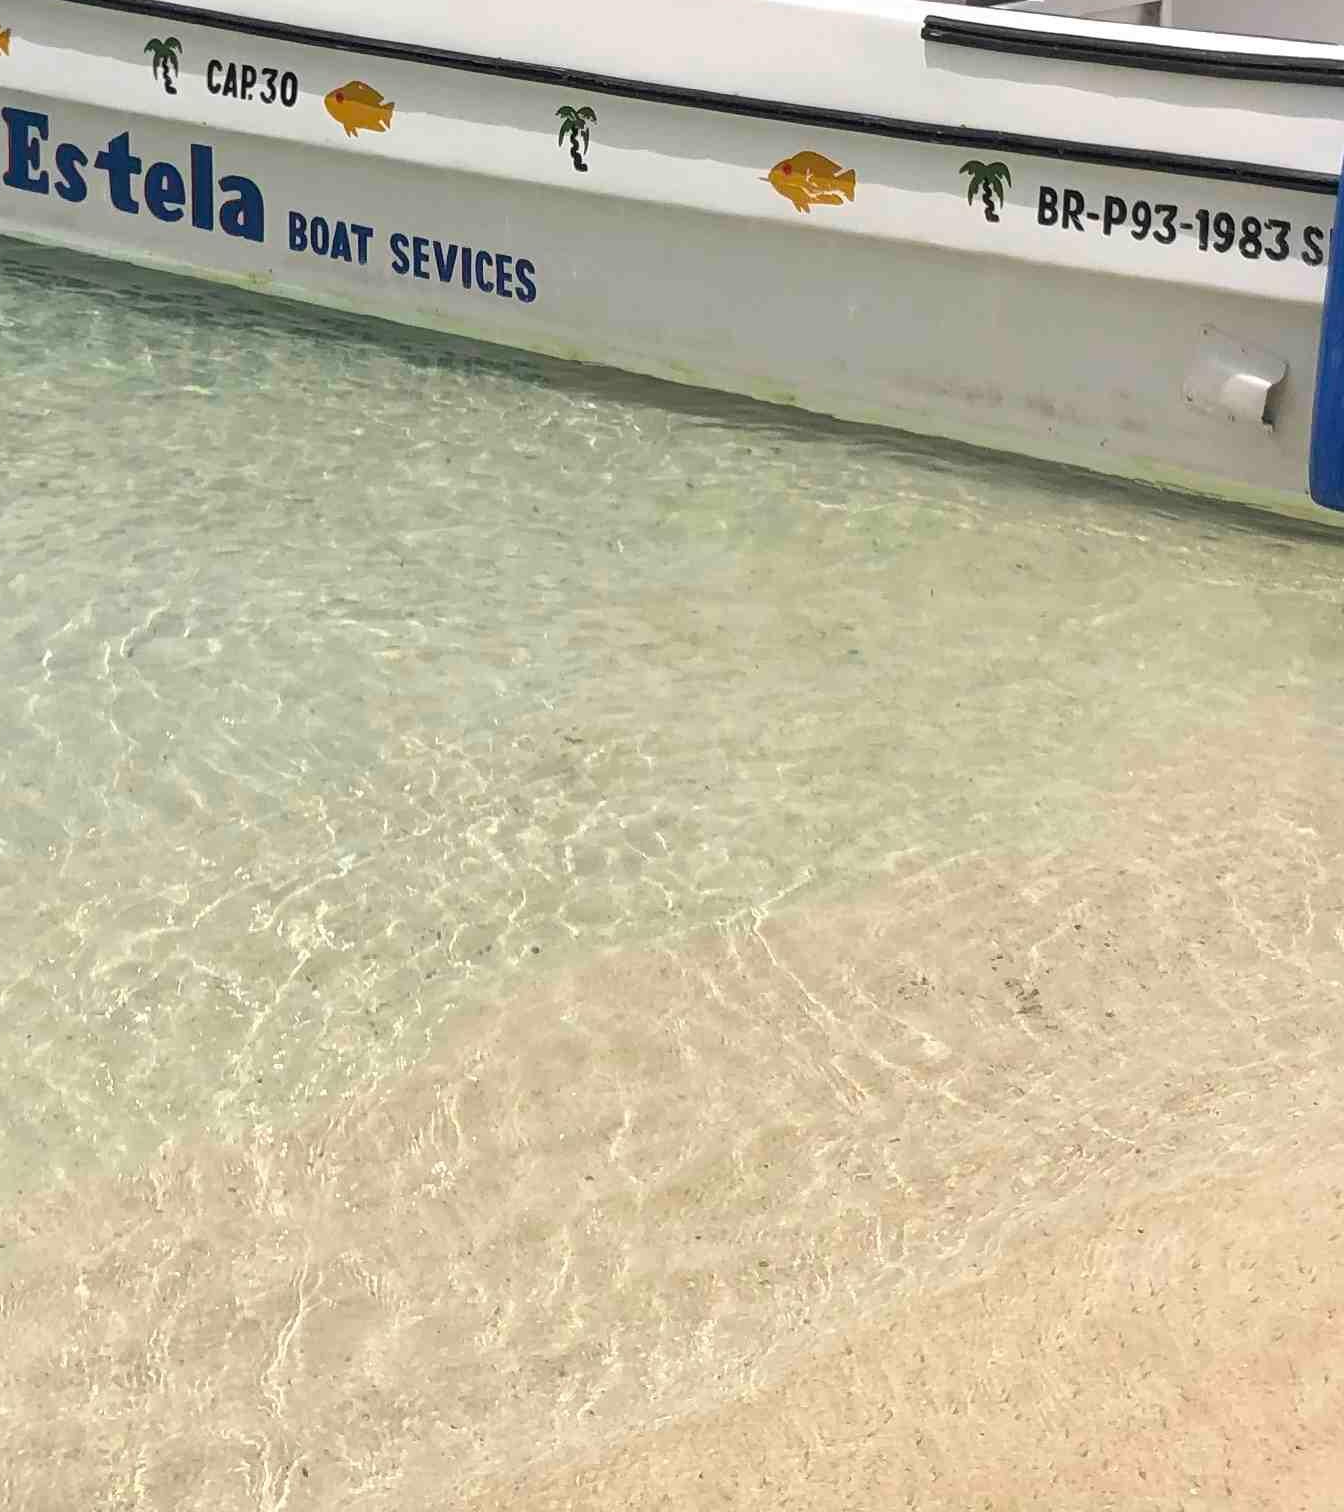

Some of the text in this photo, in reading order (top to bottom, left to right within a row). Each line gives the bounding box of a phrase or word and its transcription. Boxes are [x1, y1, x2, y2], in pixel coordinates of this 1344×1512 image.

[2, 107, 265, 243] Estela
[289, 211, 537, 303] BOAT SEVICES
[1037, 186, 1334, 267] BR-P93-1983 S
